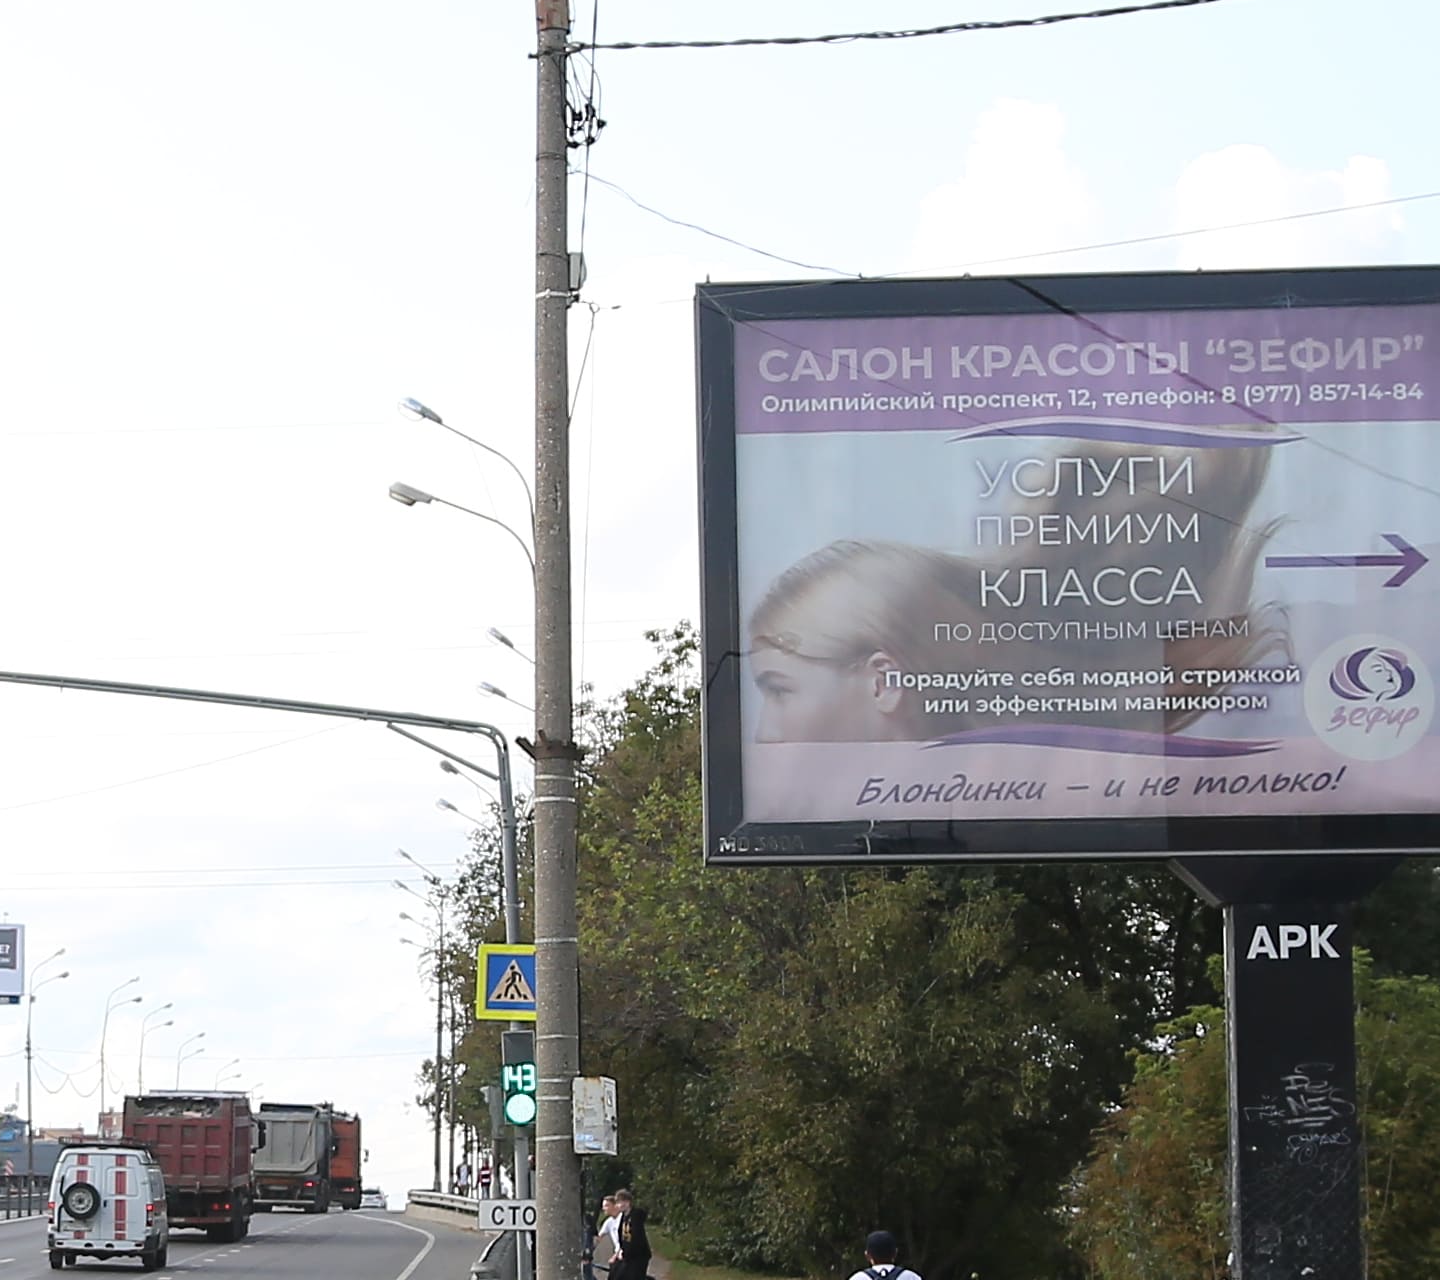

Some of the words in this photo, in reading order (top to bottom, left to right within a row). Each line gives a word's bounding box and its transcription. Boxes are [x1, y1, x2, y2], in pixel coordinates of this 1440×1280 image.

[759, 347, 933, 382] САЛОН
[951, 342, 1190, 379] КРАСОТЫ
[761, 392, 935, 413] Олимпийский
[943, 391, 1062, 413] проспект,
[1068, 389, 1097, 410] 12,
[1103, 388, 1216, 408] телефон:
[1221, 387, 1237, 403] 8
[1244, 385, 1302, 407] (977)
[1309, 383, 1424, 402] 857-14-84
[976, 456, 1194, 497] УСЛУГИ
[976, 513, 1200, 546] ПРЕМИУМ
[980, 567, 1203, 607] КЛАССА
[933, 623, 971, 641] ПО
[978, 621, 1147, 644] ДОСТУПНЫМ
[1155, 620, 1249, 641] ЦЕНАМ
[885, 670, 1014, 691] Порадуйте
[1021, 667, 1075, 686] себя
[1083, 666, 1174, 688] модной
[1182, 665, 1301, 686] стрижкой
[924, 698, 969, 714] или
[975, 694, 1118, 717] эффектным
[1124, 694, 1268, 714] маникюром
[1327, 704, 1420, 736] зефир
[856, 772, 1046, 806] Блондинки
[1104, 777, 1125, 800] и
[1139, 775, 1179, 797] не
[1193, 766, 1348, 797] только!
[503, 1064, 536, 1092] 143
[491, 1205, 536, 1225] СТО
